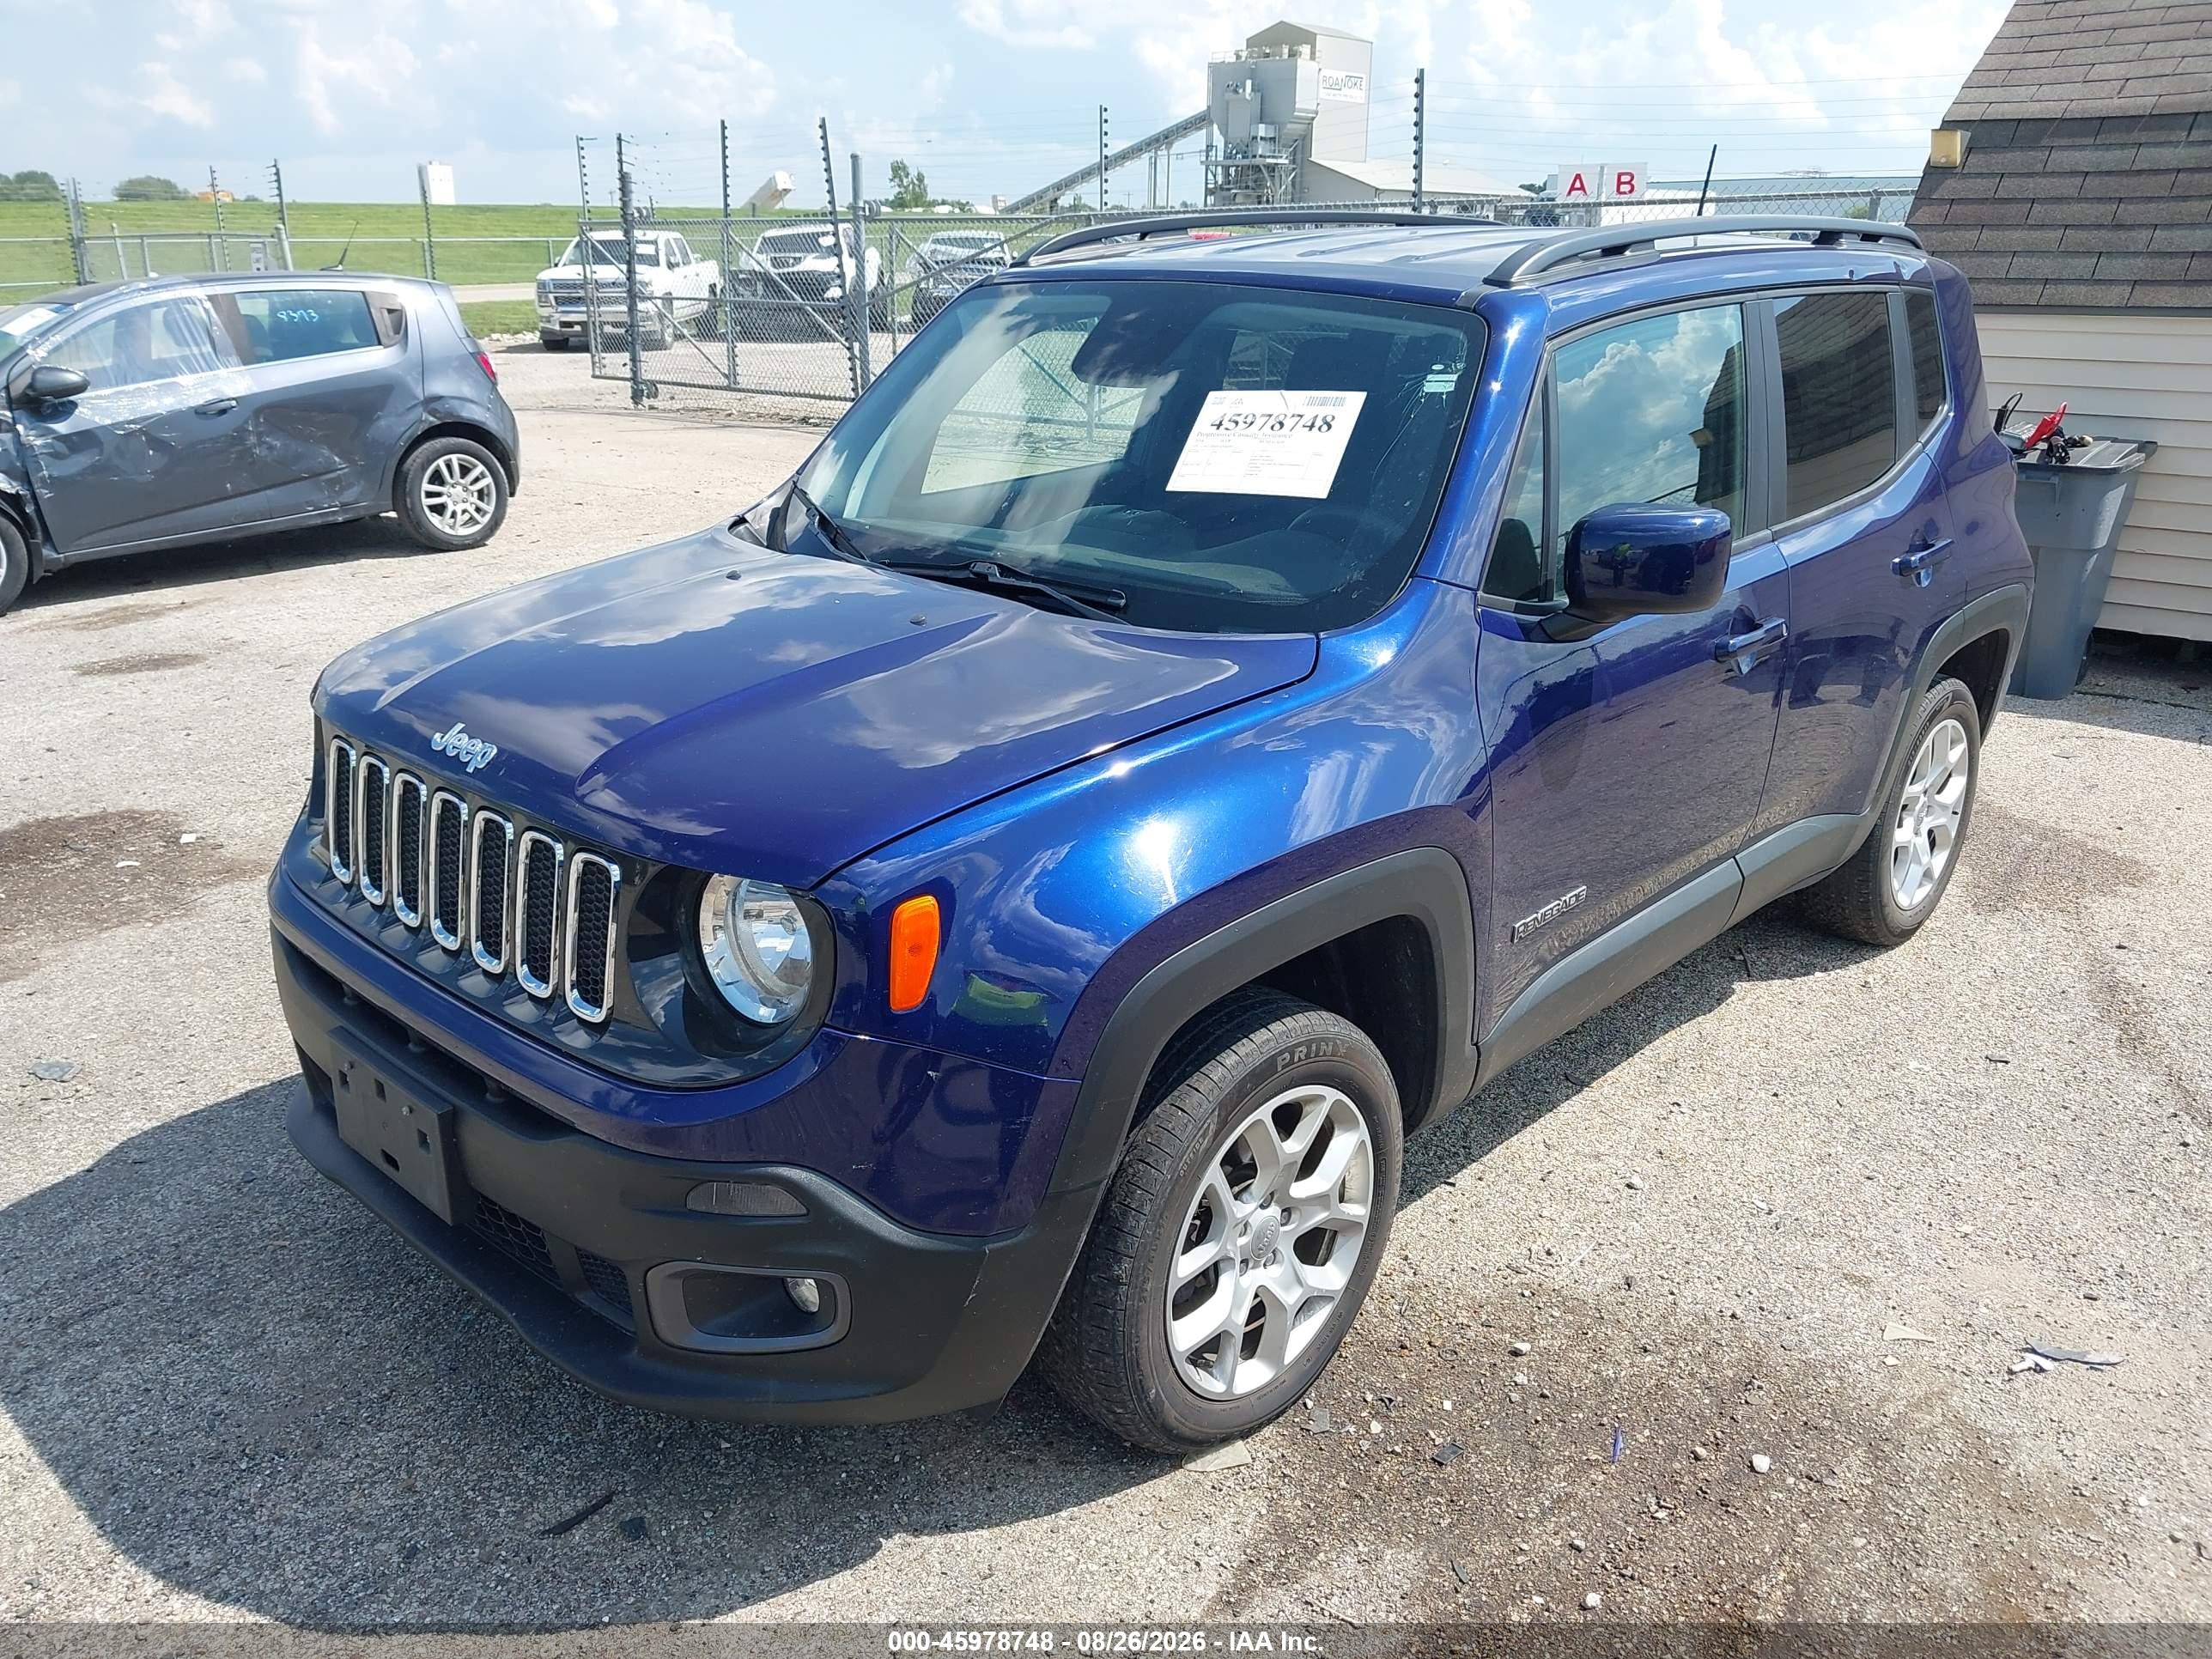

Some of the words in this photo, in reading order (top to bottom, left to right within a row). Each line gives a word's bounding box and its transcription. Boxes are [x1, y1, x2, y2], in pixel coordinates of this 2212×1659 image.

[1322, 75, 1364, 90] ROANOKE
[1565, 173, 1588, 197] A
[1615, 172, 1636, 195] B
[1210, 413, 1336, 433] 45978748
[431, 722, 497, 773] Jeep
[1513, 885, 1587, 944] RENEGADE
[1276, 1038, 1351, 1073] PRINX
